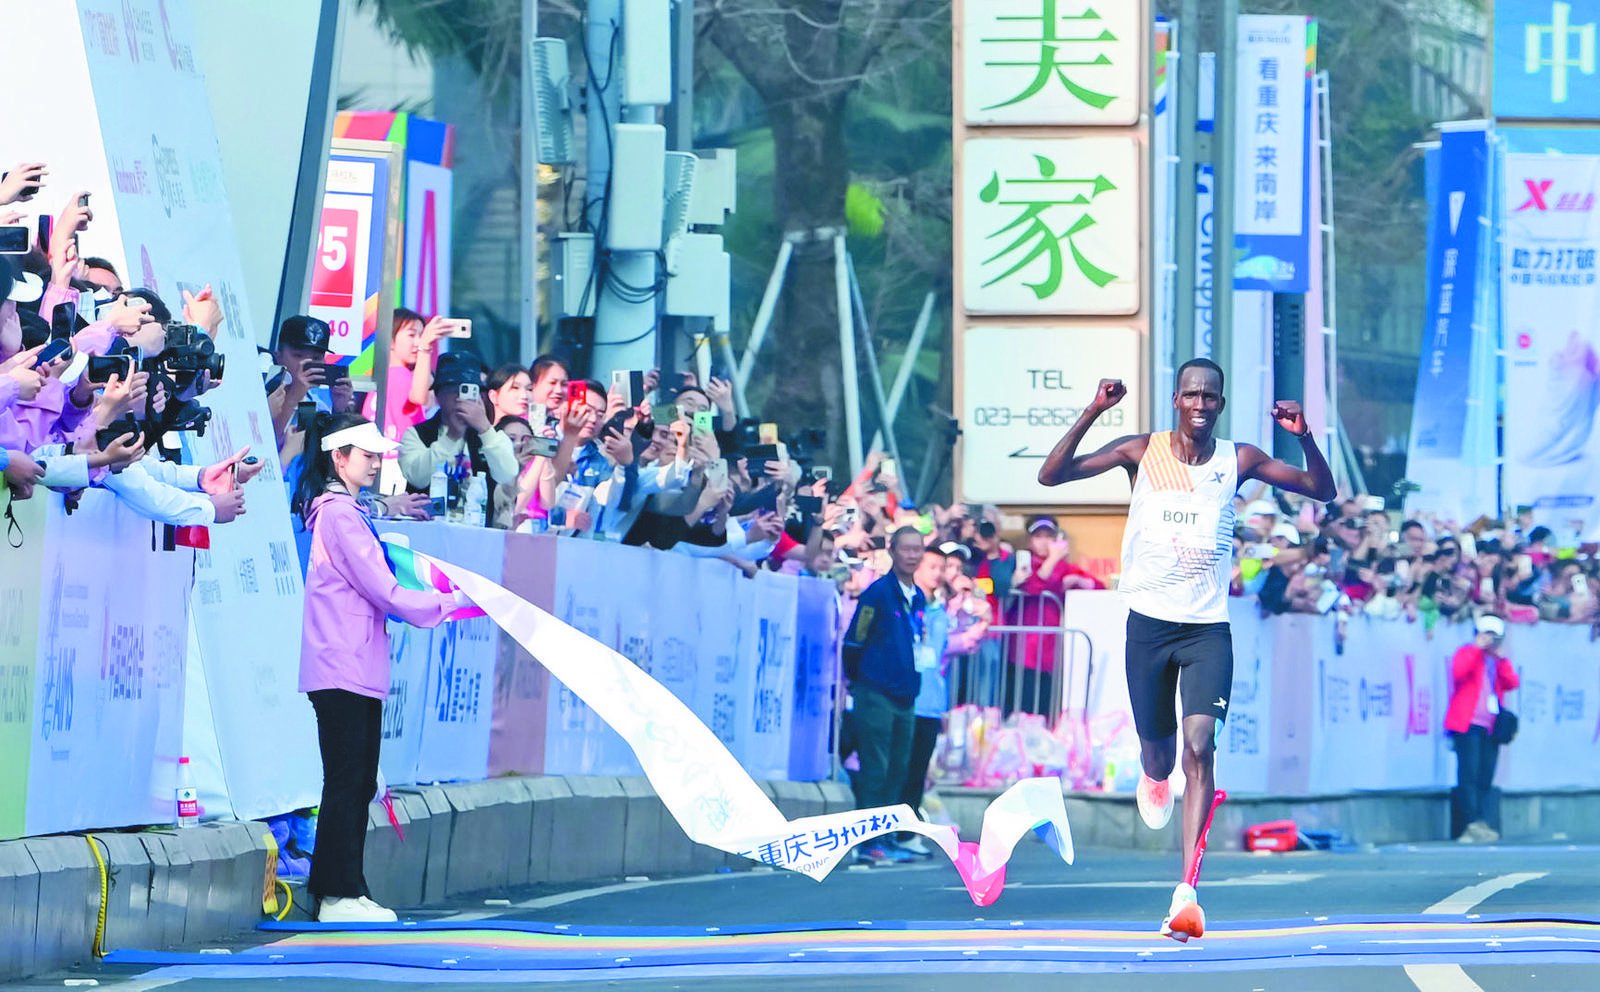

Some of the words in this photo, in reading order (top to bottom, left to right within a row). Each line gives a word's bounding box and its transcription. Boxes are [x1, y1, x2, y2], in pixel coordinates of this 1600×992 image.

[1525, 2, 1596, 103] 中
[317, 226, 348, 271] 5
[1027, 370, 1072, 389] TEL
[1163, 510, 1199, 525] BOIT
[738, 814, 899, 868] 重庆马拉松
